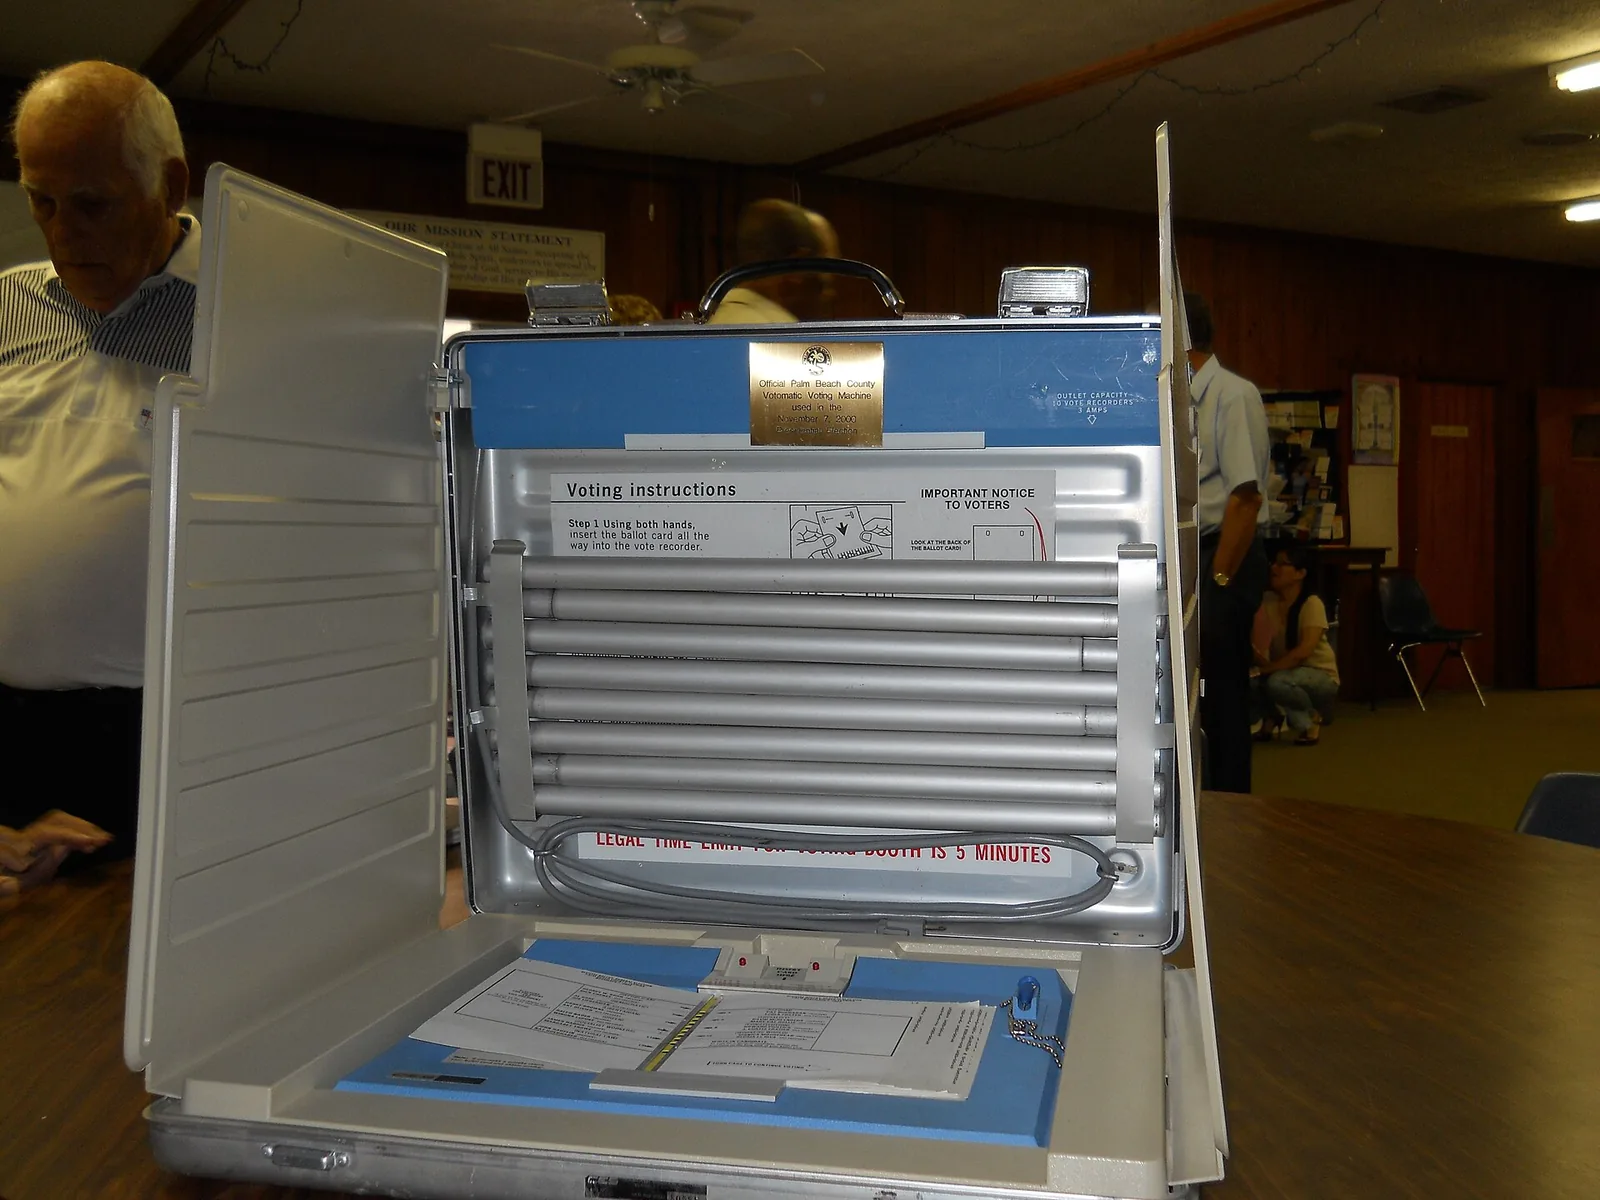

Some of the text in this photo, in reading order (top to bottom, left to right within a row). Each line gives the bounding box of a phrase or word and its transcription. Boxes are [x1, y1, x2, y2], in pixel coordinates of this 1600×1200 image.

[482, 159, 532, 200] EXIT
[385, 220, 417, 233] OUR
[425, 224, 483, 240] MISSION
[491, 230, 574, 247] STATEMENT
[759, 379, 875, 389] Official Palm Beach County
[762, 391, 872, 401] Votomatic Voting Machine
[777, 415, 818, 423] November
[835, 415, 857, 423] 2000
[567, 482, 737, 500] Voting instructions
[921, 488, 1035, 498] IMPORTANT NOTICE
[945, 500, 1010, 510] TO VOTERS
[568, 519, 696, 530] Step 1 Using both hands,
[569, 530, 710, 540] insert the ballot card all the
[570, 541, 703, 551] way into the vote recorder.
[596, 832, 645, 847] LEGAL
[931, 846, 947, 860] IS
[956, 845, 966, 860] 5
[975, 844, 1051, 863] MINUTES
